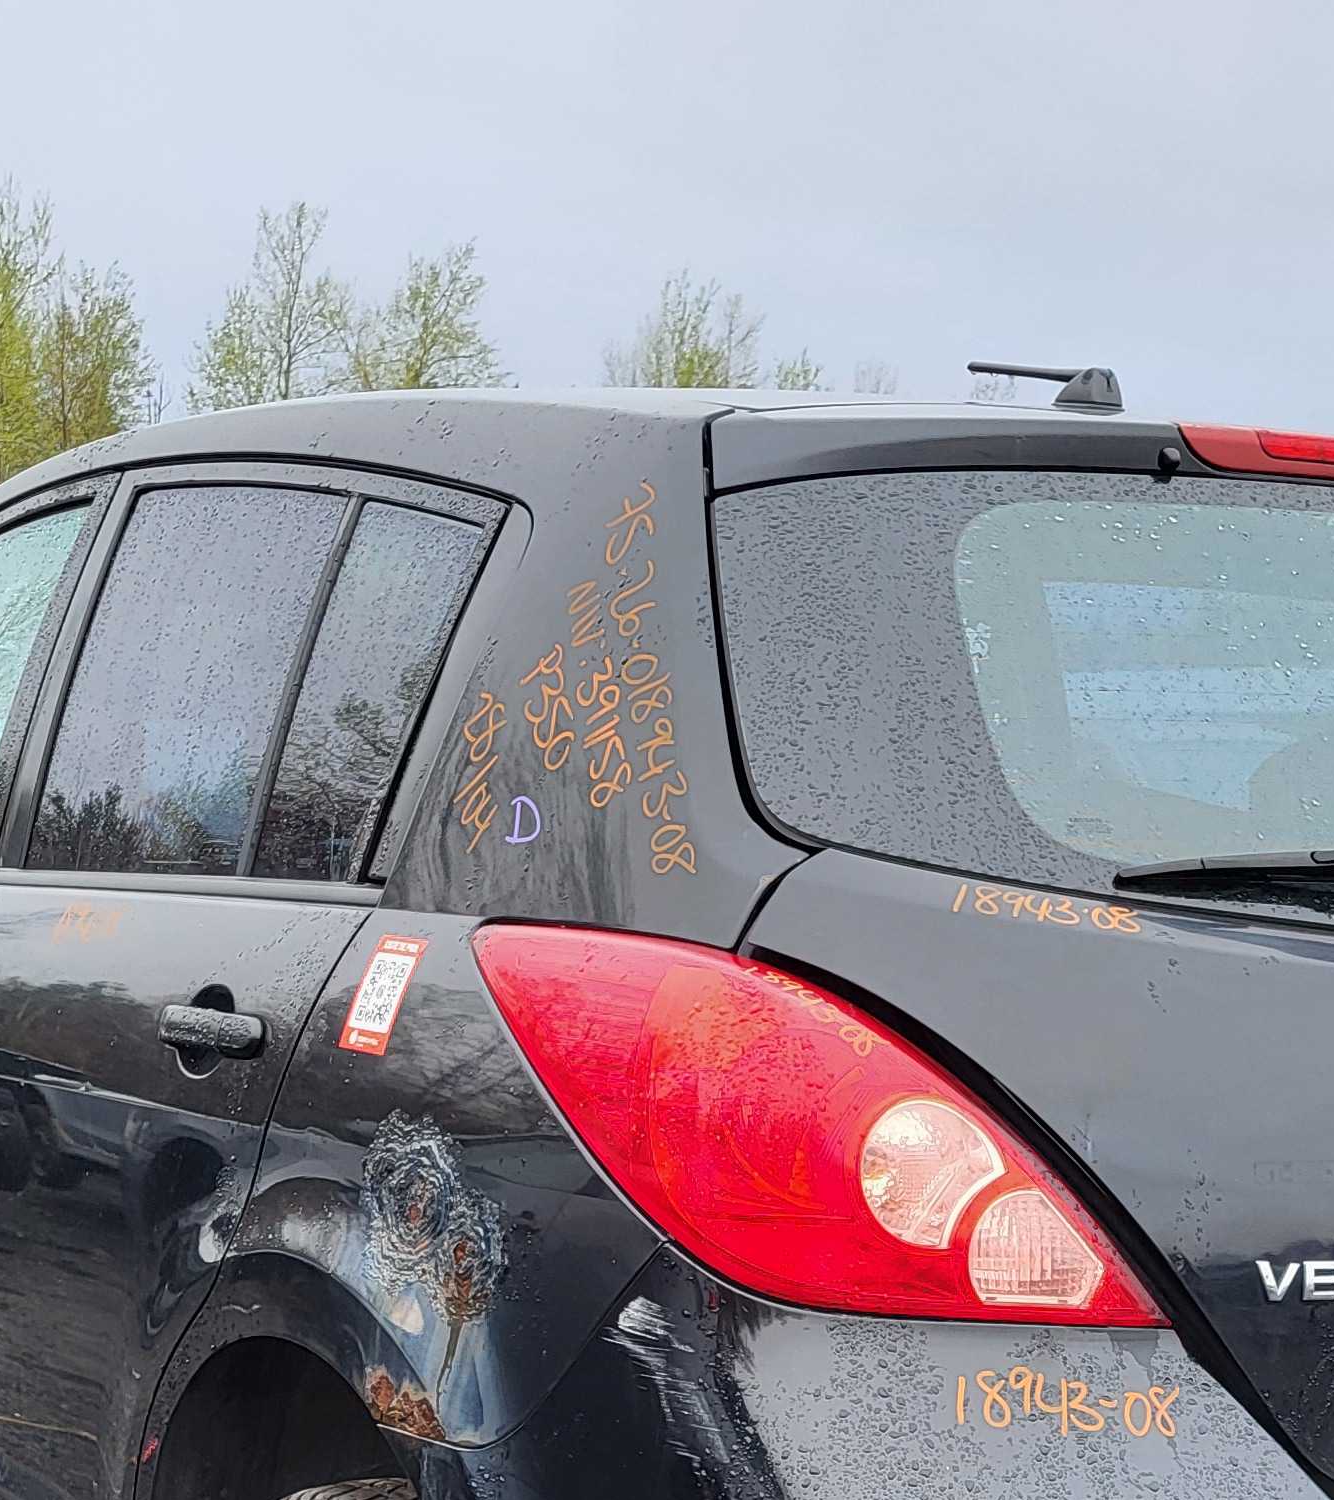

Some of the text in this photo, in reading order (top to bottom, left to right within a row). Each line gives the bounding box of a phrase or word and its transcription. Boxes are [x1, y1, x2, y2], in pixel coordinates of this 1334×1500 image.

[520, 644, 575, 771] P350
[506, 795, 542, 845] D
[956, 1365, 1180, 1437] 18943-08
